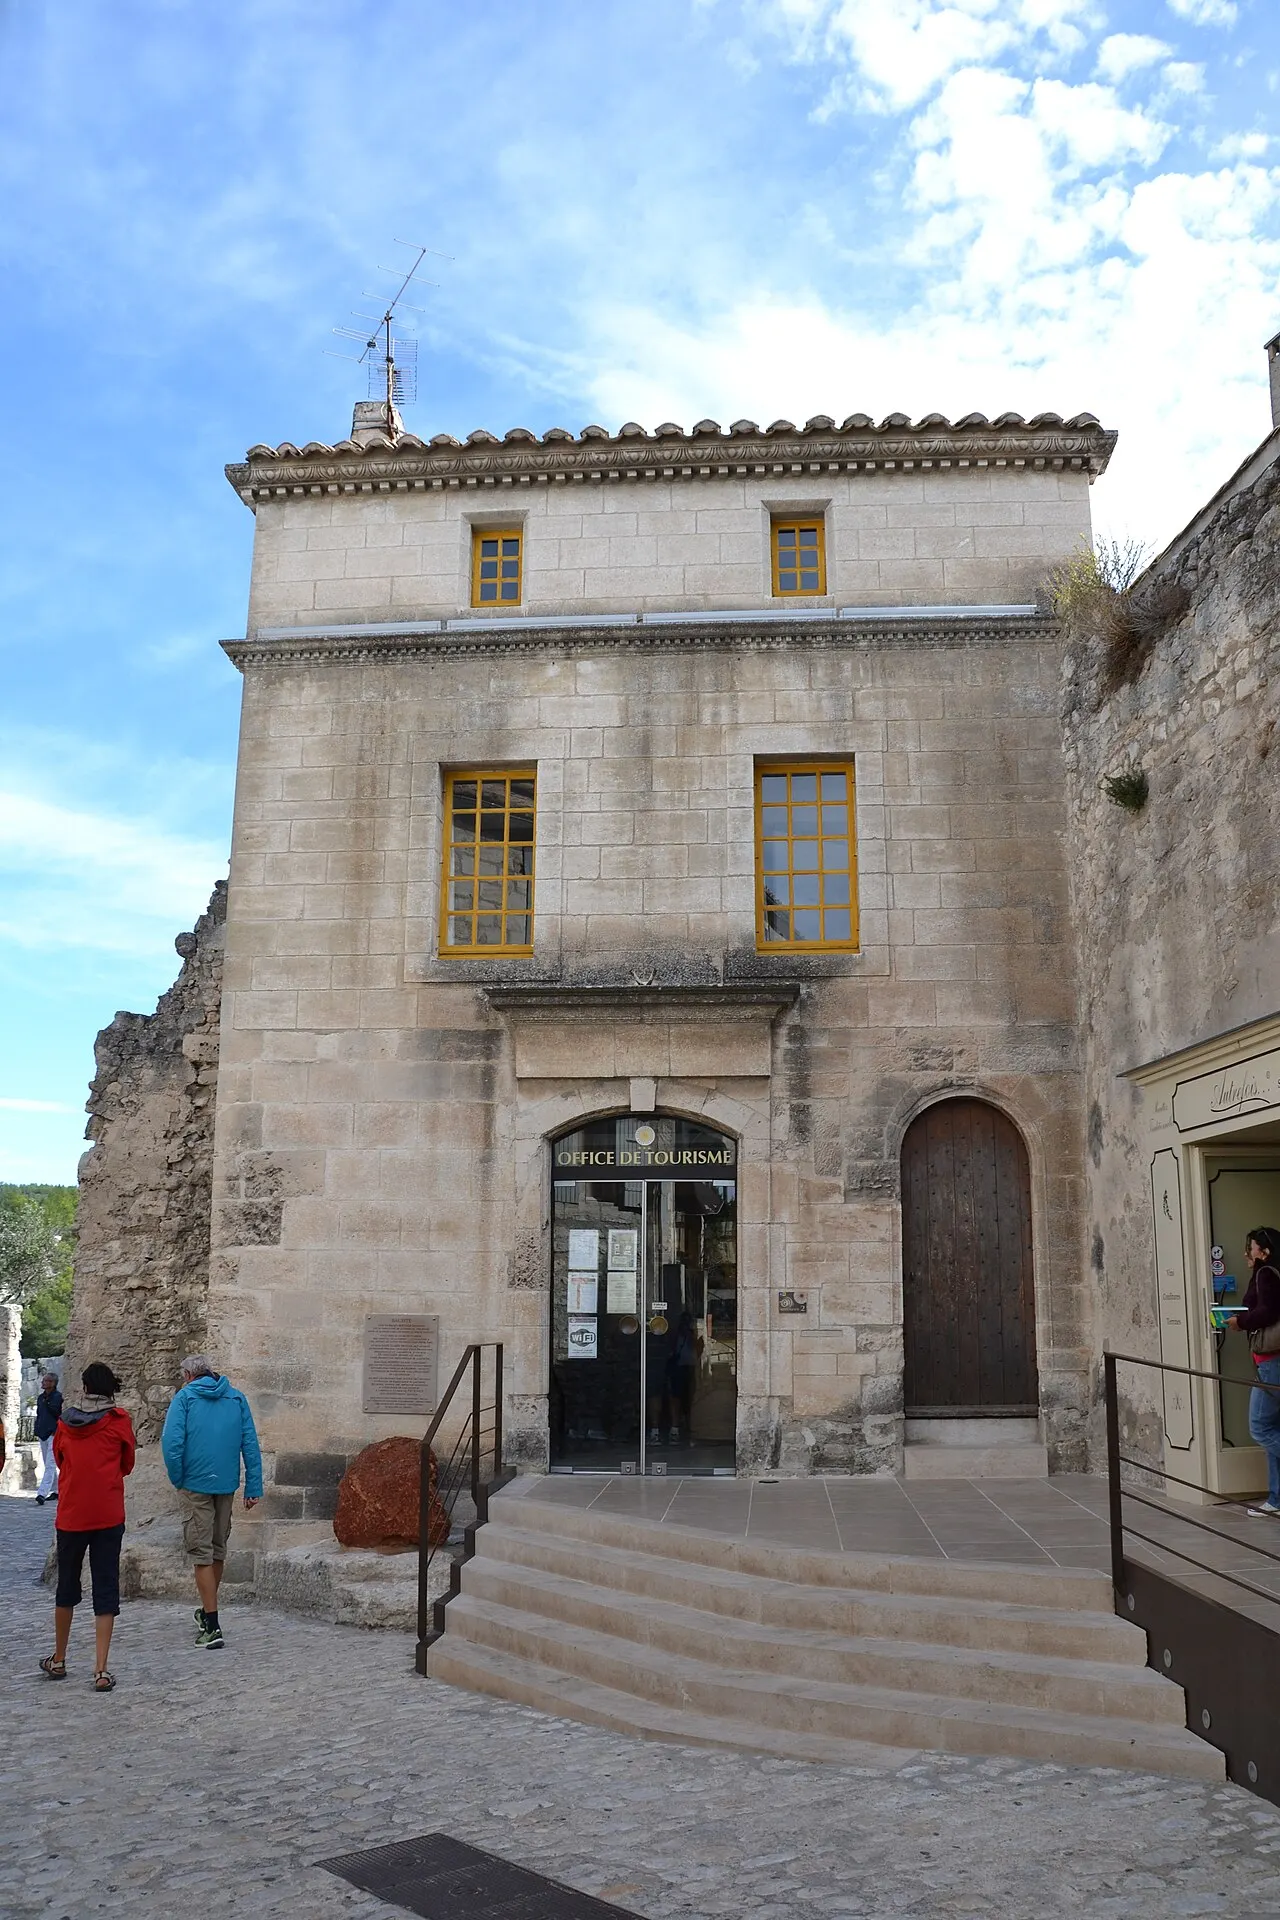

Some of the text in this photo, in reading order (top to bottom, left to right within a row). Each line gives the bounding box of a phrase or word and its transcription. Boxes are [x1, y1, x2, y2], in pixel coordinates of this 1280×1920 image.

[557, 1150, 731, 1166] OFFICE DE TOURISME
